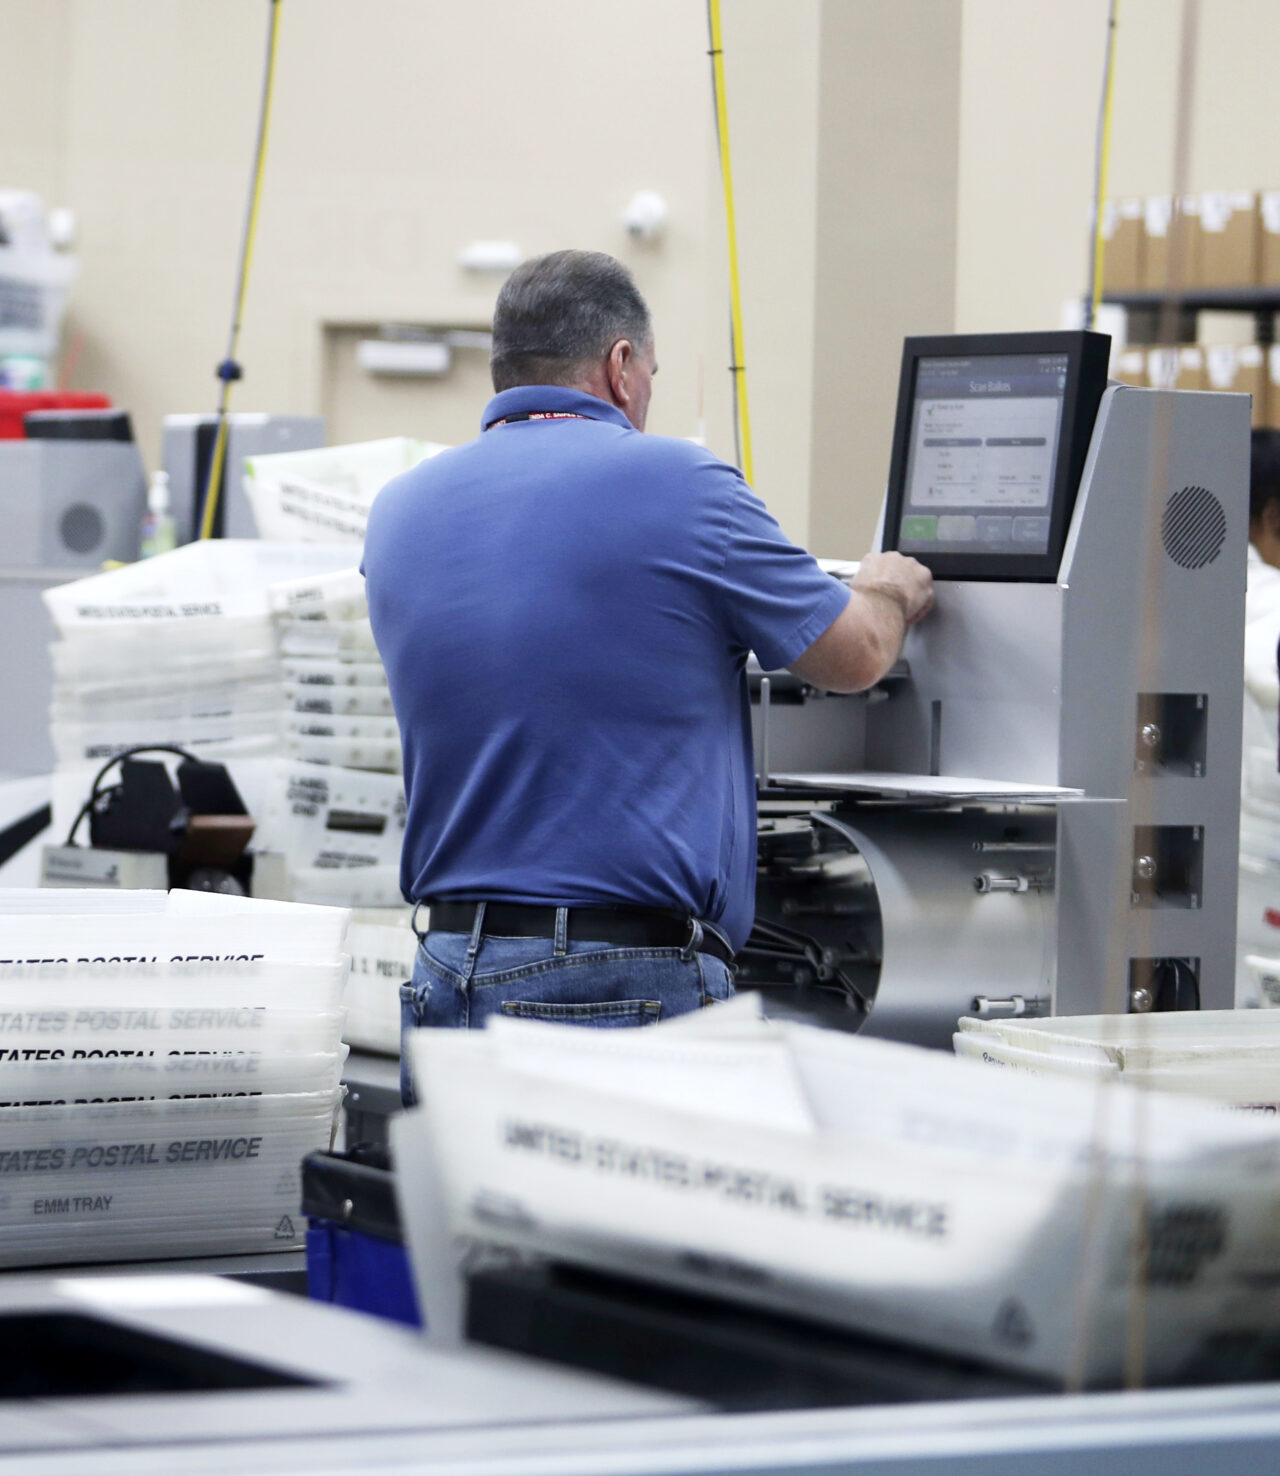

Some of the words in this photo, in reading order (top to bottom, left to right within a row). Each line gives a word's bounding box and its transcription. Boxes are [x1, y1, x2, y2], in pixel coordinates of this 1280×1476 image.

[74, 1010, 161, 1032] POSTAL
[170, 1008, 265, 1031] SERVICE
[71, 1144, 160, 1168] POSTAL
[166, 1136, 264, 1162] SERVICE
[33, 1198, 70, 1215] EMM
[73, 1195, 113, 1213] TRAY
